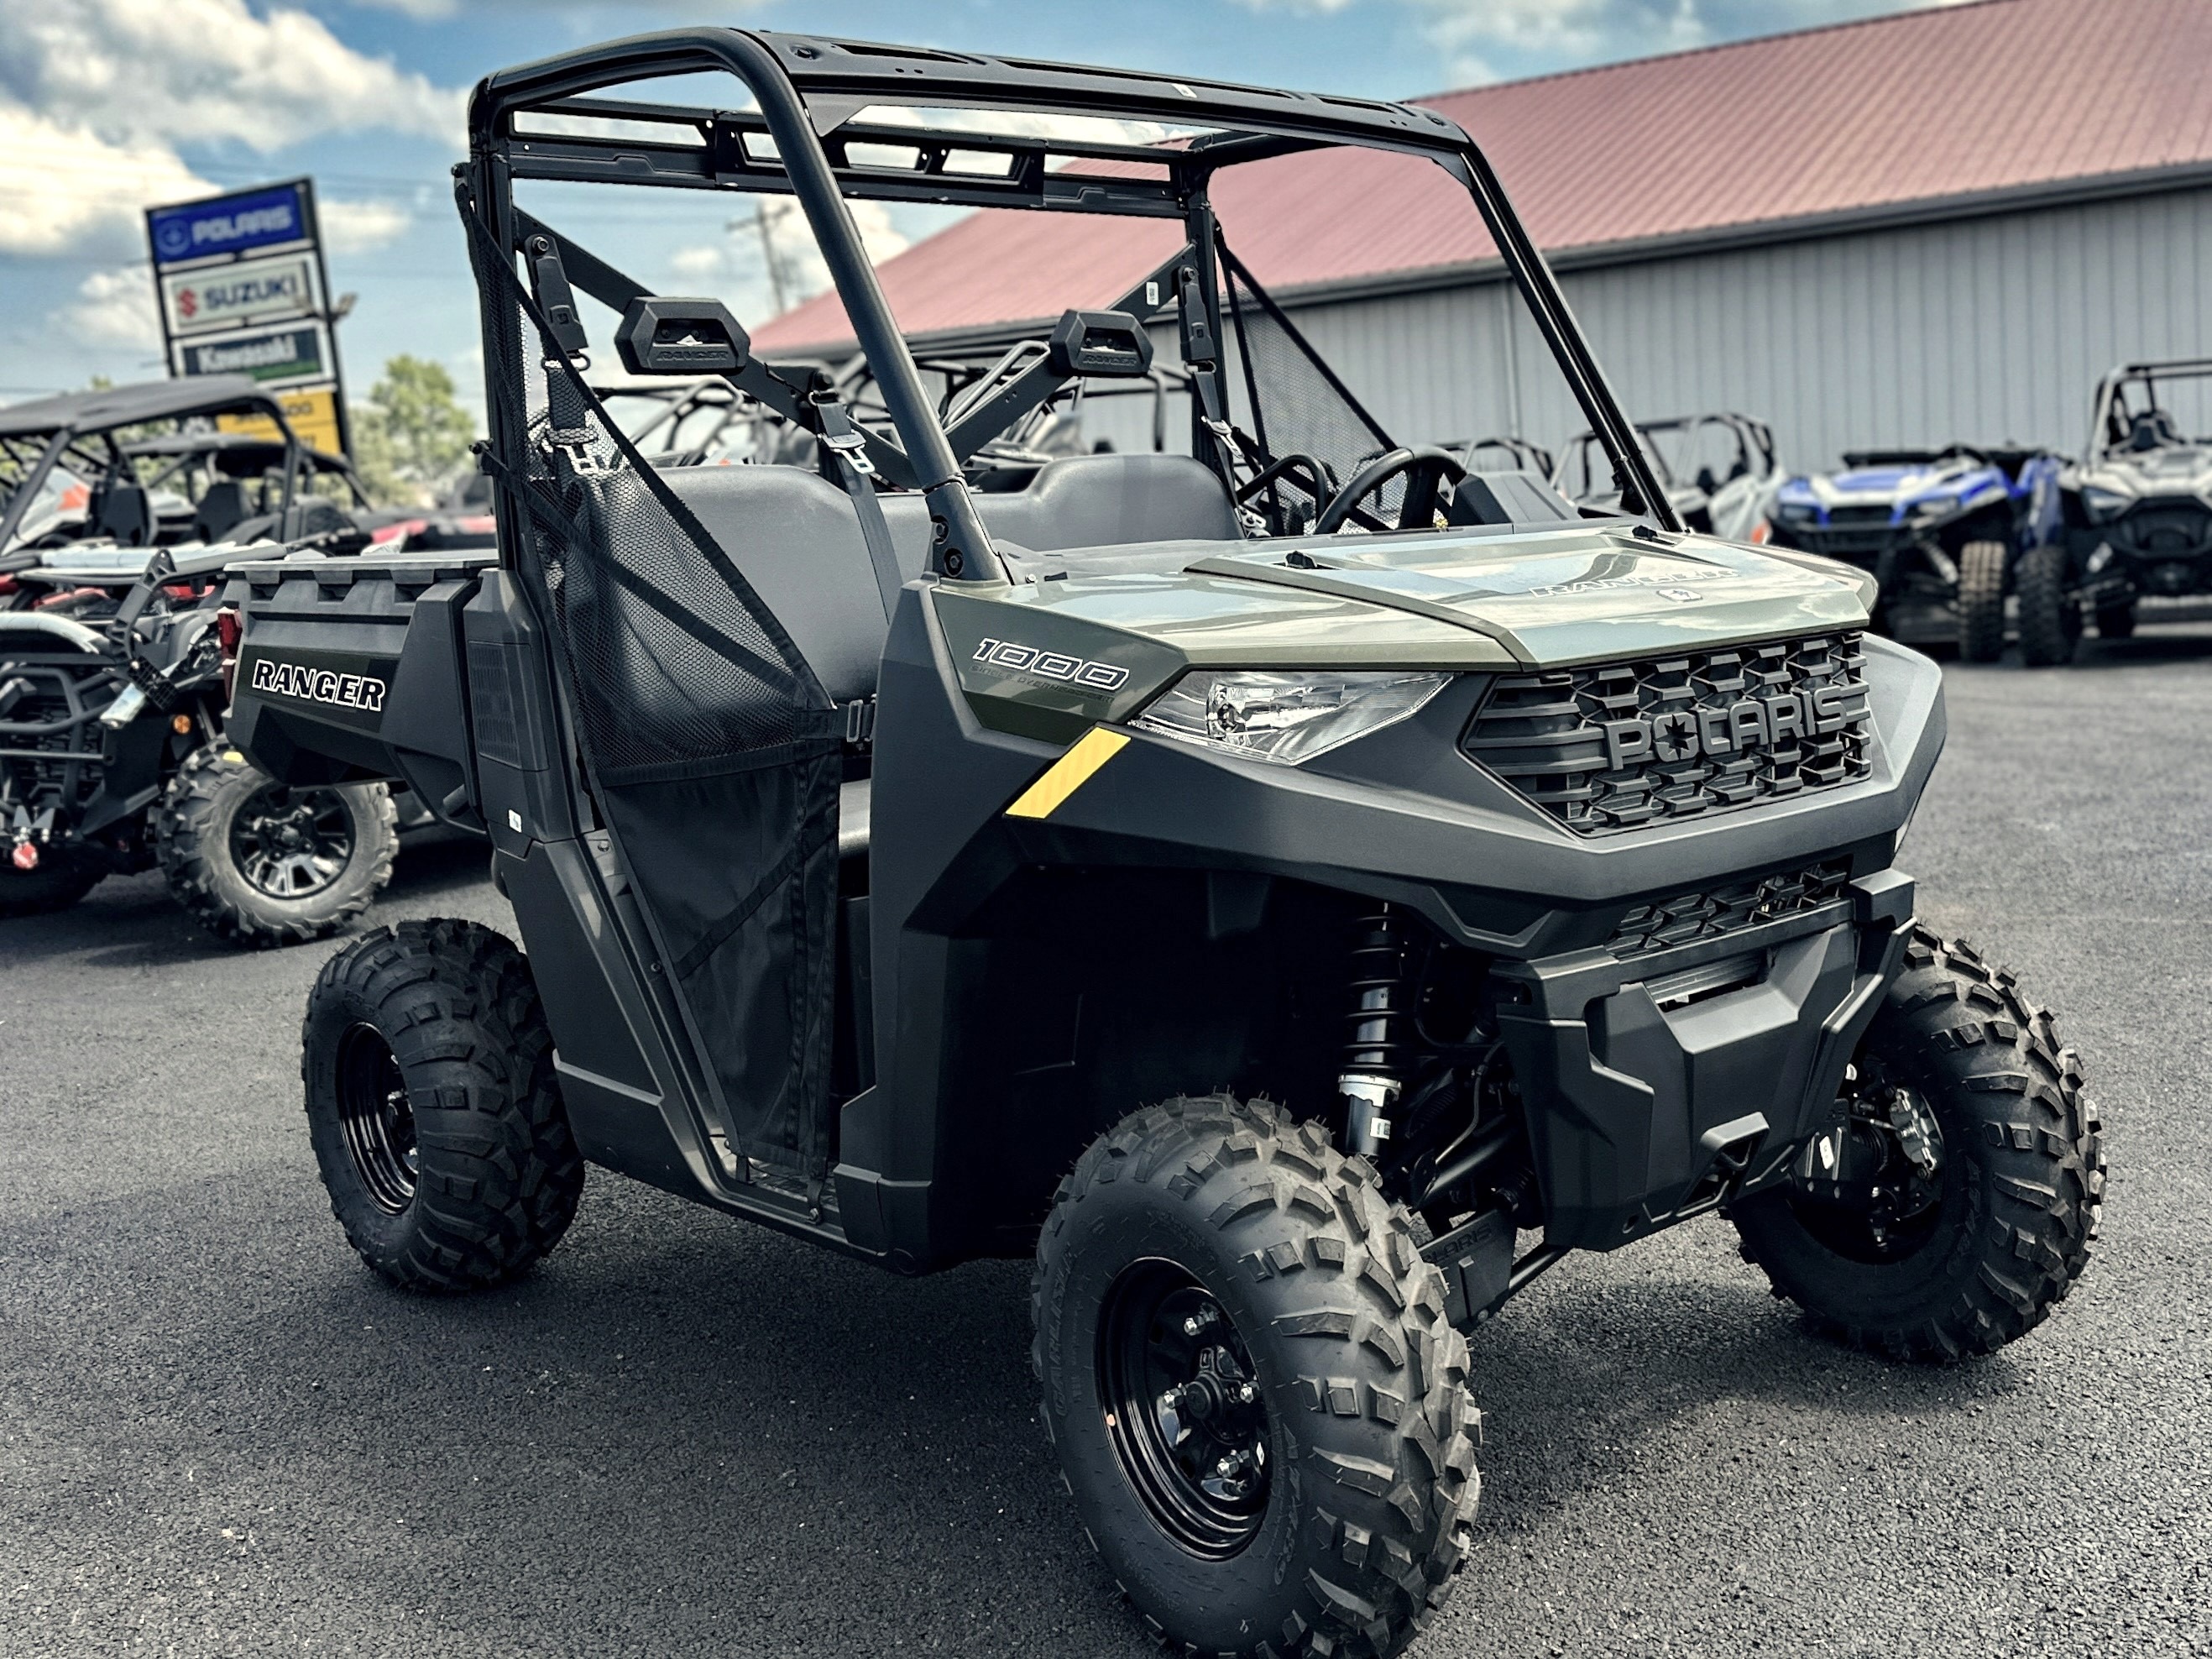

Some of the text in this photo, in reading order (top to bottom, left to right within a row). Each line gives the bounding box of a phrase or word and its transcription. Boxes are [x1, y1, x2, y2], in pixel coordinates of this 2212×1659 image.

[191, 205, 293, 244] POLARIS
[205, 274, 297, 309] SUZUKI
[252, 658, 386, 712] RANGER
[973, 637, 1130, 691] 1000
[1604, 684, 1848, 771] POLARIS
